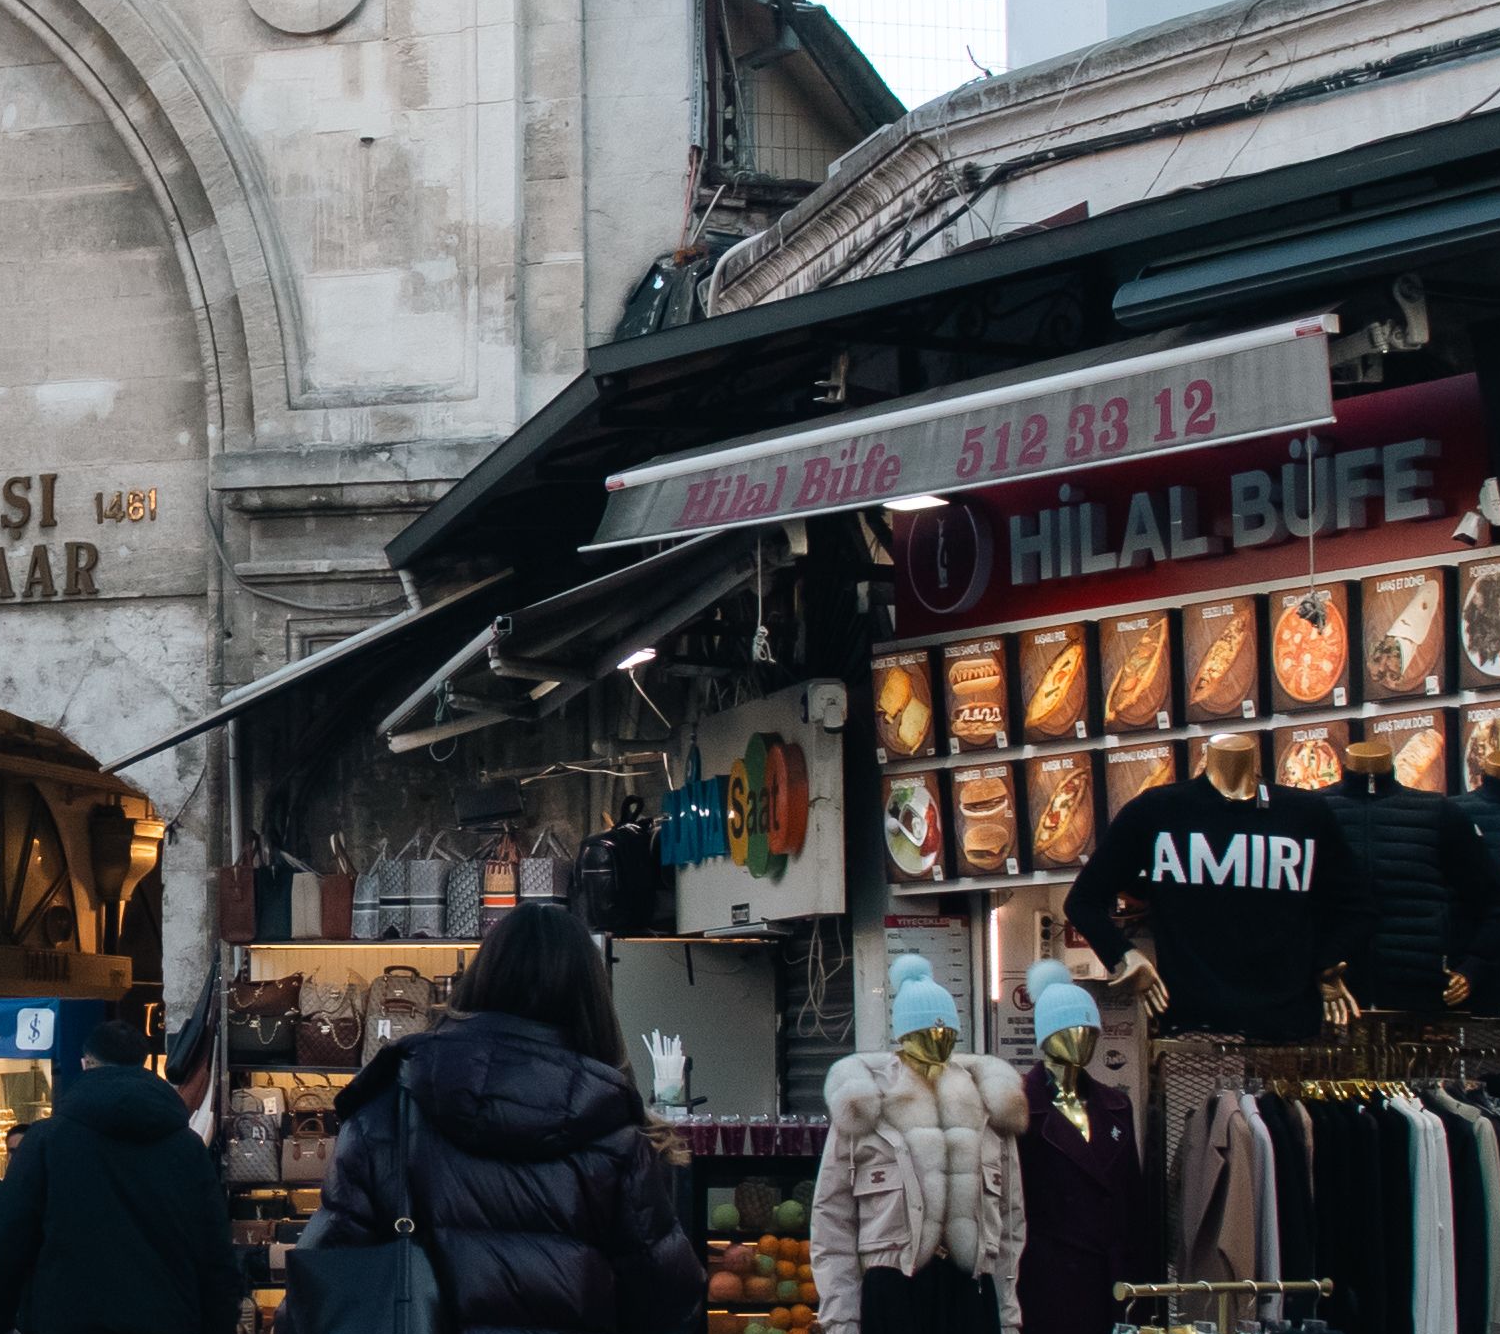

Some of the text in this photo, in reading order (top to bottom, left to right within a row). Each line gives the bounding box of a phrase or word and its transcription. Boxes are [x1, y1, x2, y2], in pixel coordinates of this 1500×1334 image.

[674, 378, 1216, 528] Hilal Büfe 512 33 12
[1009, 434, 1438, 586] HİLAL BÜFE
[730, 774, 781, 839] Saat
[1151, 831, 1316, 892] AMIRI
